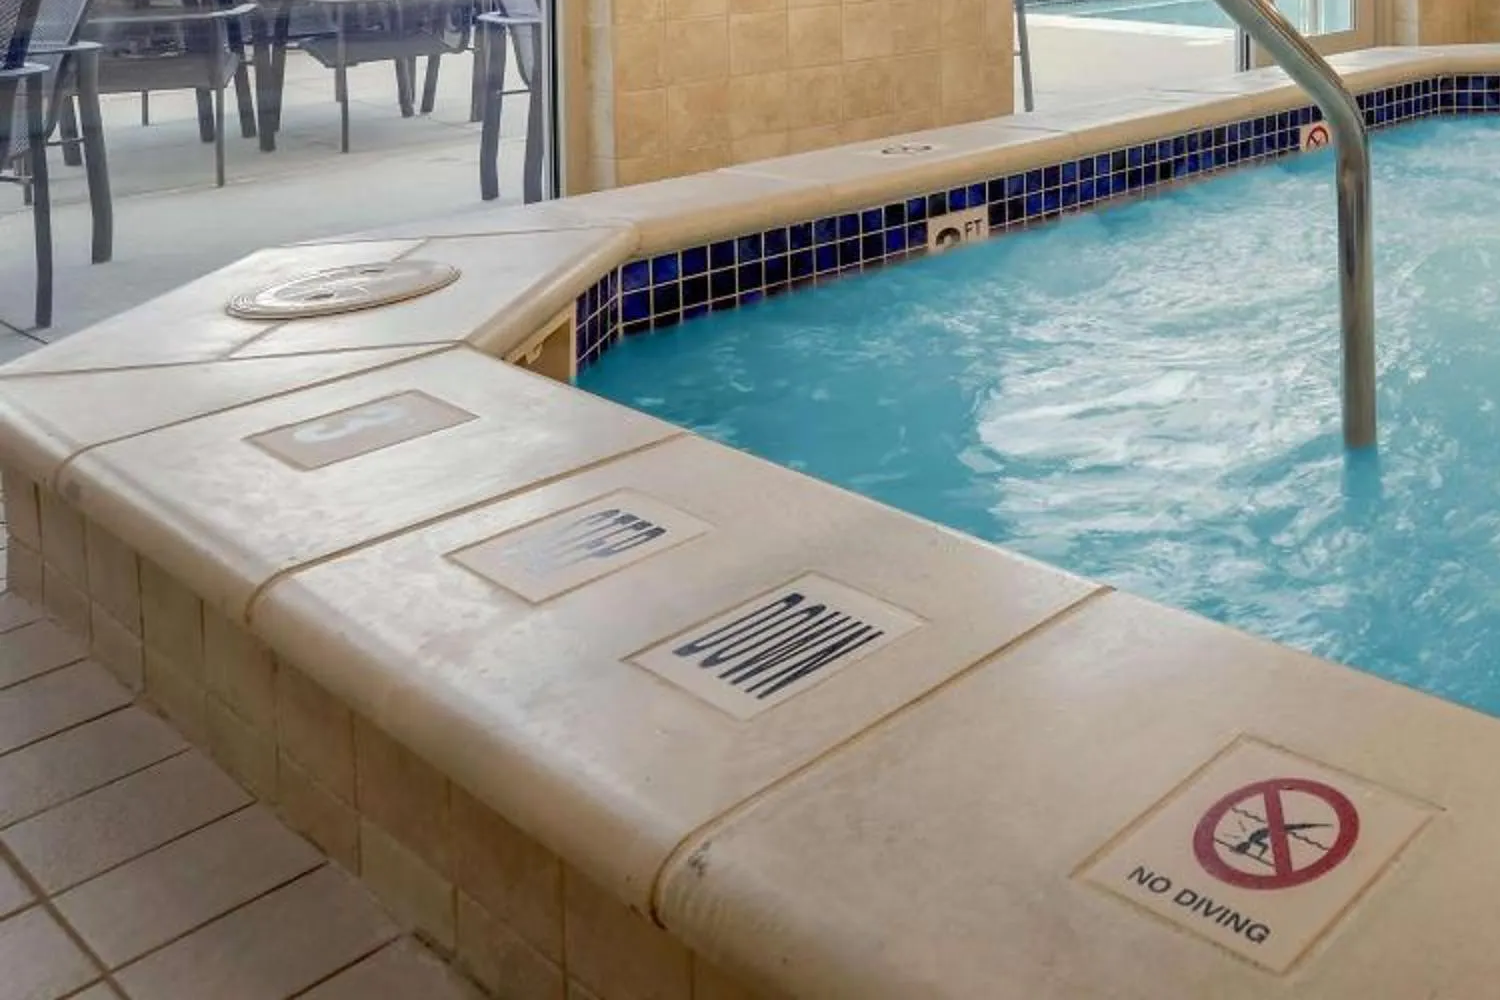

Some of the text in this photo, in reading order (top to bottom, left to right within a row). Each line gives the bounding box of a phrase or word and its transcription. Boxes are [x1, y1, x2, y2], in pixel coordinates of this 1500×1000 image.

[964, 217, 984, 241] FT
[671, 592, 885, 700] DOWN
[1127, 866, 1271, 943] NO DIVING
